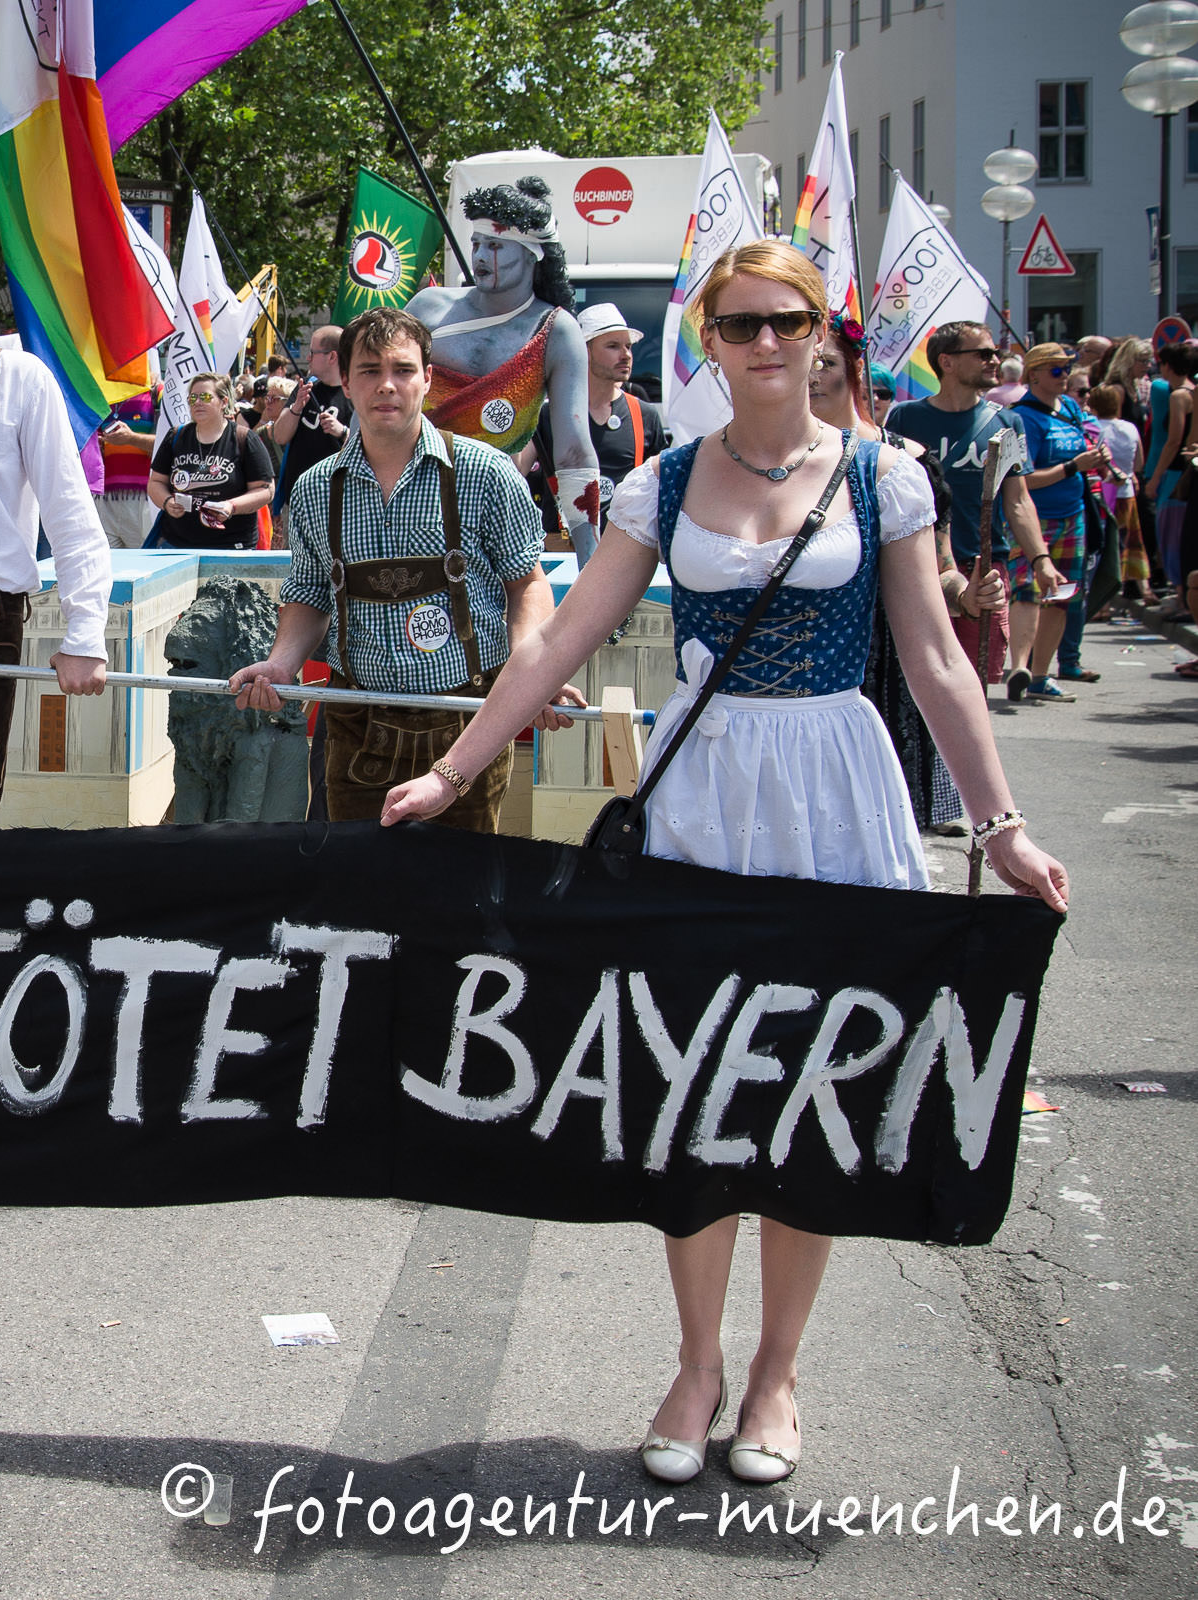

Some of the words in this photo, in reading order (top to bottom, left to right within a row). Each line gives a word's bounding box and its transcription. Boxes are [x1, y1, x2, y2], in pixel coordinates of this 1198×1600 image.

[574, 189, 633, 203] BUCHBINDER
[413, 608, 441, 622] STOP
[412, 617, 447, 633] HOMO
[413, 627, 450, 641] PHOBIA
[401, 953, 1026, 1174] BAYERN
